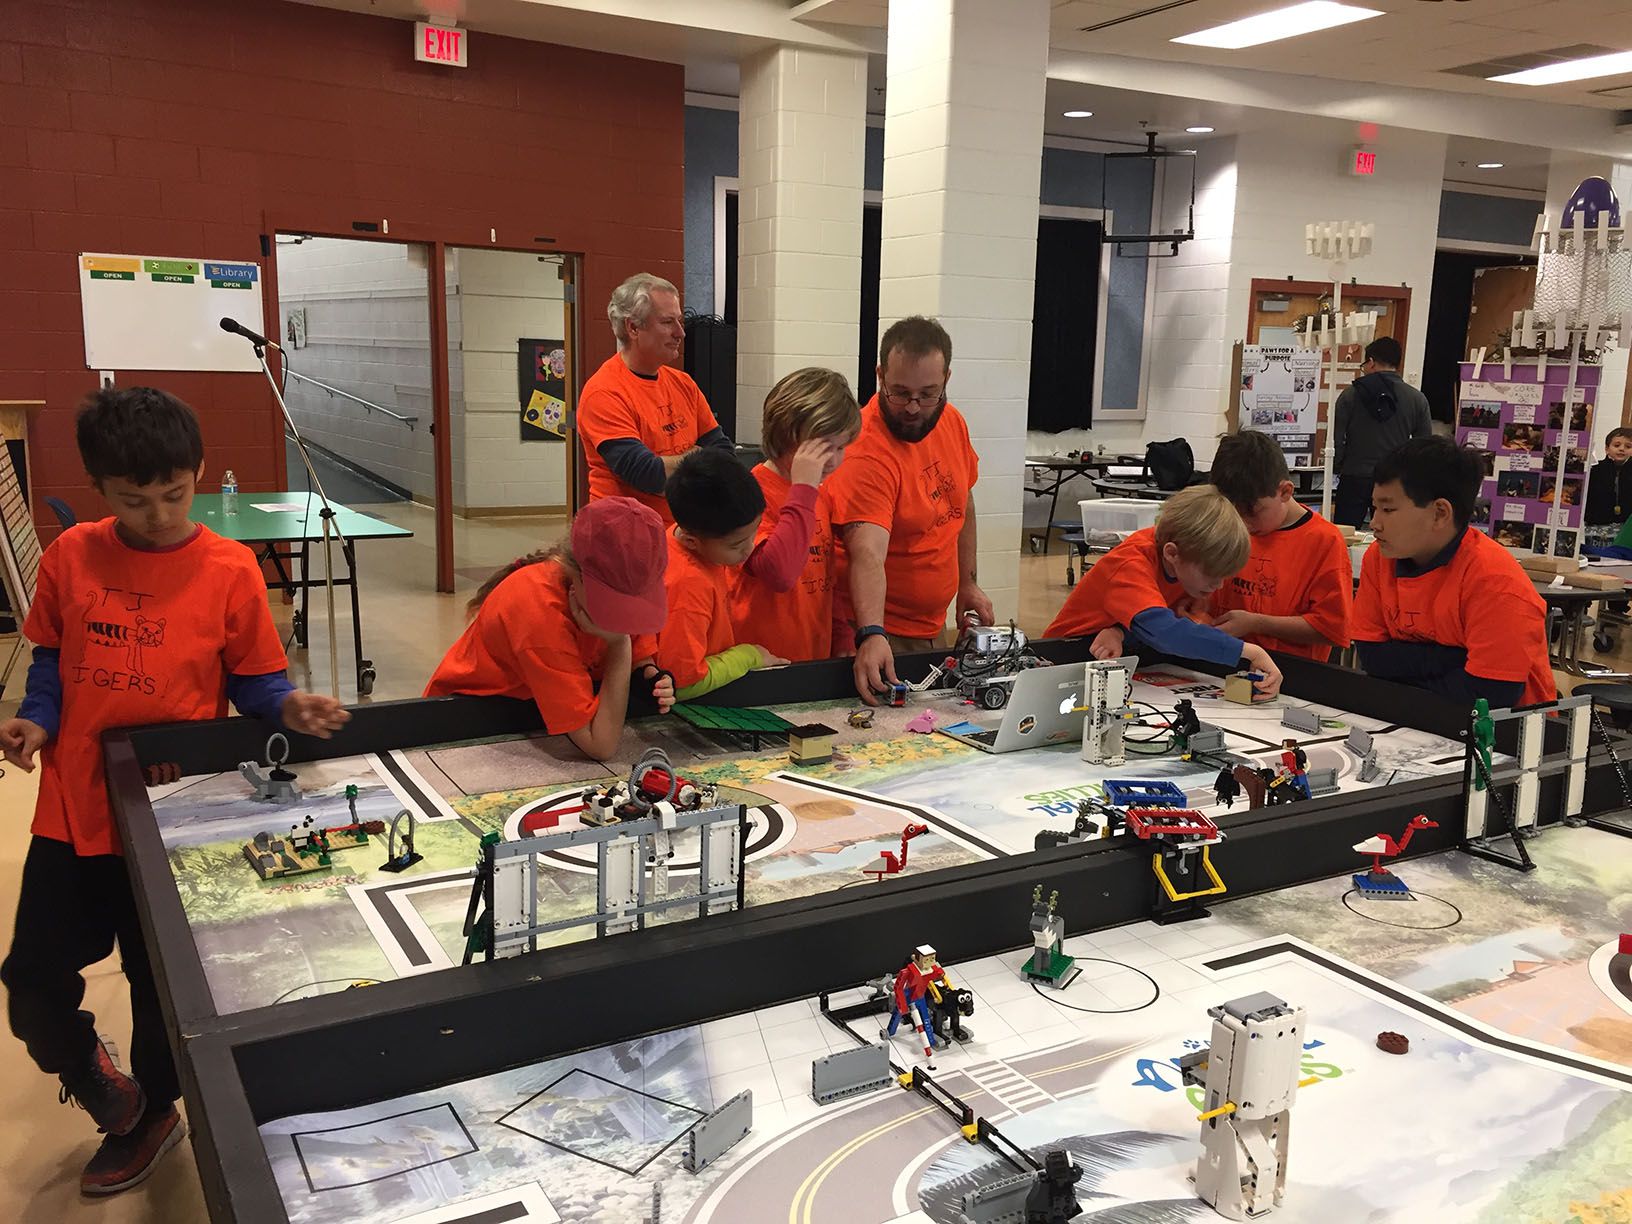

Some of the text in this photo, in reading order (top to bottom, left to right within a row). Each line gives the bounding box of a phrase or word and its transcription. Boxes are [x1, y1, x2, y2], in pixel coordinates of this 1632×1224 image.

[425, 27, 462, 62] EXIT
[1357, 152, 1376, 174] EXIT
[220, 269, 253, 279] Library
